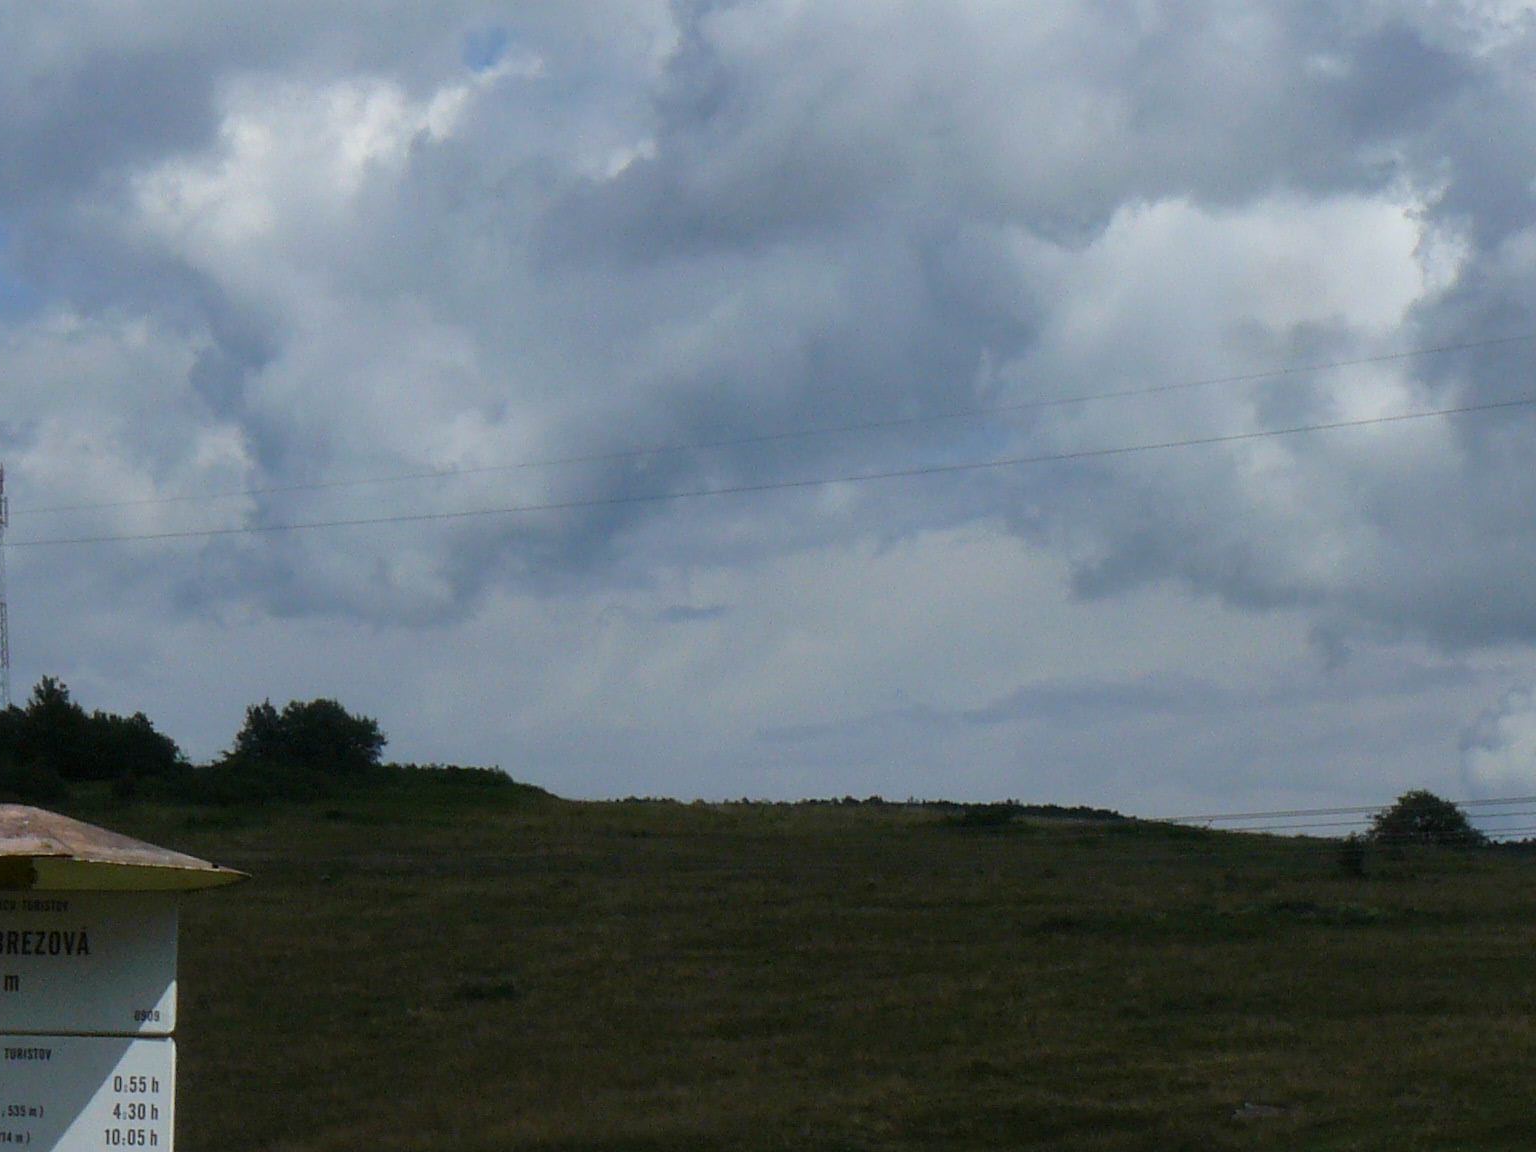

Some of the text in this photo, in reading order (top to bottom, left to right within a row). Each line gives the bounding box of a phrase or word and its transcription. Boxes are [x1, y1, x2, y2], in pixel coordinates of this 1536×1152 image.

[4, 974, 20, 992] m
[4, 1048, 52, 1061] TURISTOV
[151, 1076, 159, 1093] h
[151, 1104, 159, 1120] h
[150, 1129, 158, 1146] h
